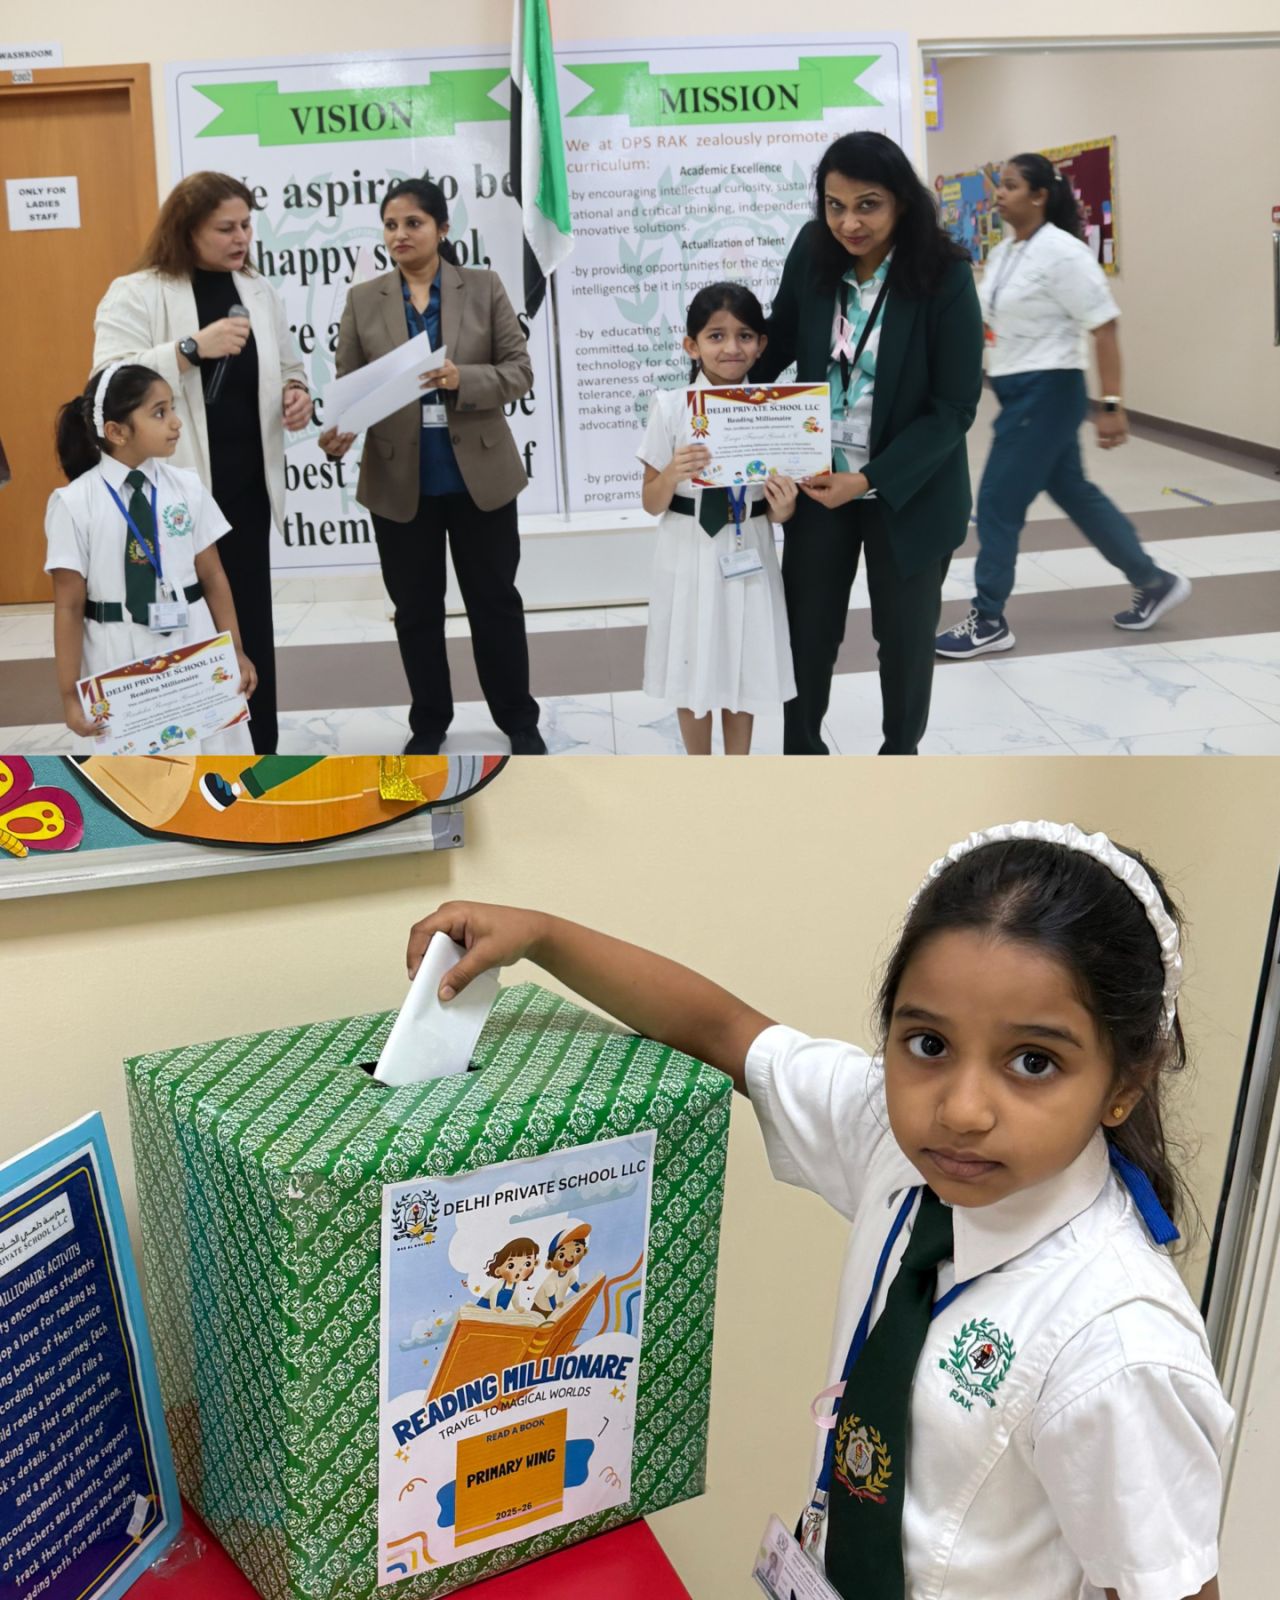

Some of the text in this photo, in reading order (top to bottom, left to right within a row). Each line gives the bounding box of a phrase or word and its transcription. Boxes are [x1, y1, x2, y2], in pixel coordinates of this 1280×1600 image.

[660, 84, 800, 115] MISSION
[290, 100, 413, 135] VISION
[566, 139, 590, 151] We
[599, 139, 612, 150] at
[621, 136, 652, 150] DPS
[656, 134, 688, 148] RAK
[696, 132, 762, 147] zealously
[766, 130, 829, 147] promote
[566, 158, 650, 174] curriculum:
[680, 162, 782, 176] Academic Excellence
[18, 186, 67, 196] ONLY FOR
[568, 190, 585, 201] -by
[588, 186, 657, 200] encouraging
[660, 183, 722, 196] intellectual
[724, 181, 774, 195] curiosity,
[26, 200, 60, 209] LADIES
[29, 212, 58, 221] STAFF
[616, 206, 639, 218] and
[641, 204, 681, 217] critical
[684, 202, 735, 216] thinking,
[572, 220, 690, 237] nnovative solutions.
[681, 235, 785, 250] Actualization of Talent
[256, 240, 360, 286] happy
[571, 265, 588, 277] -by
[591, 262, 643, 277] providing
[645, 258, 720, 274] opportunities
[721, 257, 737, 269] for
[740, 257, 759, 269] the
[571, 282, 641, 297] intelligences
[643, 281, 656, 293] be
[660, 281, 669, 292] it
[671, 280, 682, 291] in
[751, 278, 763, 288] or
[575, 328, 594, 340] -by
[601, 325, 661, 338] educating
[575, 342, 634, 356] committed
[637, 342, 649, 352] to
[576, 358, 642, 372] technology
[645, 356, 663, 367] for
[577, 374, 639, 387] awareness
[642, 372, 654, 384] of
[578, 389, 636, 401] tolerance,
[578, 403, 622, 416] making
[624, 404, 632, 413] a
[579, 418, 639, 432] advocating
[284, 454, 348, 491] best
[583, 473, 601, 485] -by
[583, 489, 642, 503] programs
[105, 683, 133, 697] DELHI
[135, 672, 172, 689] PRIVATE
[173, 660, 209, 676] SCHOOL
[209, 654, 225, 665] LLC
[129, 686, 161, 700] Reading
[160, 673, 200, 690] Millionaire
[443, 1159, 648, 1217] DELHI PRIVATE SCHOOL LLC
[23, 1228, 52, 1251] SCHOOL
[47, 1241, 81, 1276] ACTIVITY
[10, 1285, 59, 1326] encourages
[59, 1258, 96, 1291] students
[13, 1339, 20, 1350] a
[19, 1326, 39, 1346] love
[40, 1313, 55, 1331] for
[55, 1289, 86, 1319] reading
[85, 1282, 97, 1297] by
[13, 1351, 41, 1378] books
[41, 1338, 52, 1355] of
[53, 1325, 74, 1347] their
[75, 1304, 101, 1330] choice
[0, 1383, 34, 1416] cording
[34, 1365, 56, 1388] their
[58, 1338, 91, 1372] journey.
[90, 1321, 108, 1345] Each
[12, 1351, 104, 1432] reads a book and fills a
[392, 1353, 634, 1447] READING MILLIONARE
[949, 1387, 975, 1413] RAK
[0, 1442, 25, 1469] ading
[24, 1431, 40, 1449] slip
[41, 1410, 60, 1434] that
[61, 1383, 97, 1418] captures
[96, 1370, 111, 1388] the
[438, 1385, 592, 1441] TRAVEL TO MAGICAL WORLDS
[49, 1442, 56, 1453] a
[56, 1419, 80, 1447] short
[486, 1418, 546, 1443] READ A BOOK
[15, 1420, 104, 1507] and a parent's note of
[64, 1465, 86, 1491] With
[85, 1453, 100, 1471] the
[100, 1423, 129, 1458] support
[466, 1447, 557, 1489] PRIMARY WING
[495, 1501, 533, 1521] 2025-26
[2, 1553, 14, 1572] of
[15, 1521, 56, 1561] teachers
[55, 1503, 71, 1525] and
[15, 1472, 131, 1588] track their progress and make
[50, 1489, 138, 1581] both fun and rewarding
